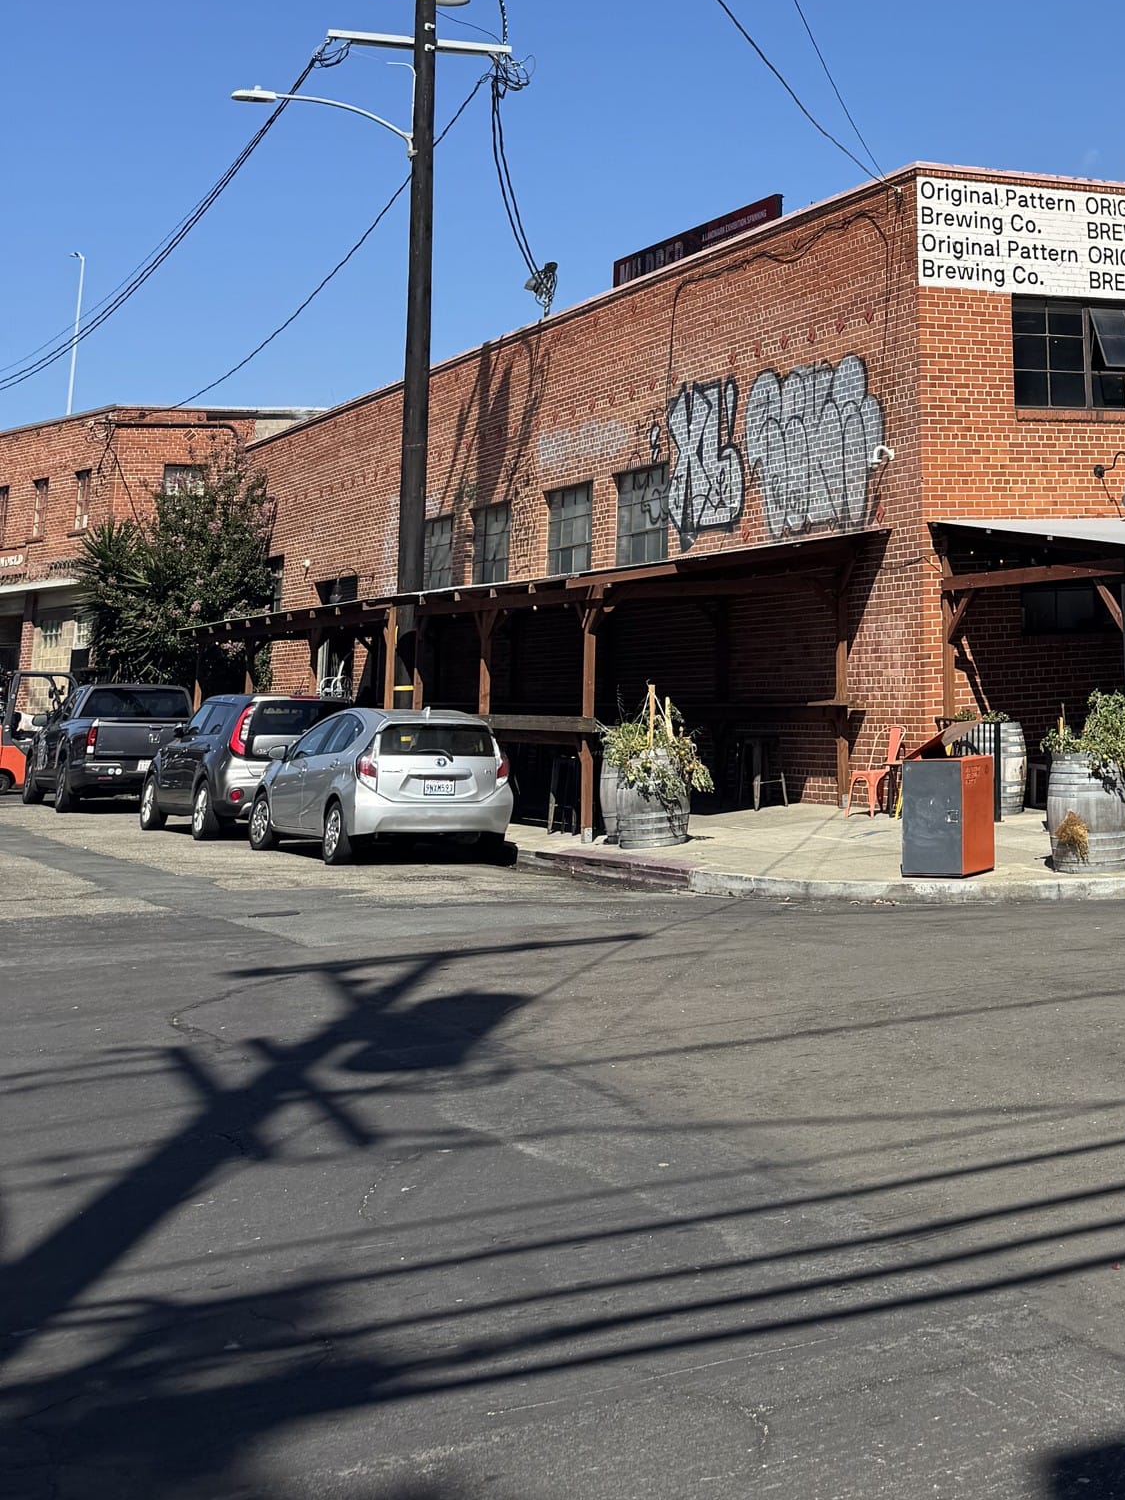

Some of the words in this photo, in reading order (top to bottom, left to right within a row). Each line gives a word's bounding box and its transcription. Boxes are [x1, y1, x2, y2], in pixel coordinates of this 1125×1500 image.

[921, 181, 998, 207] Original
[1005, 189, 1075, 213] Pattern
[922, 207, 1003, 235] Brewing
[1011, 214, 1042, 234] Co.
[922, 234, 1000, 260] Original
[1008, 241, 1078, 263] Pattern
[923, 259, 1005, 287] Brewing
[1013, 266, 1044, 286] Co.
